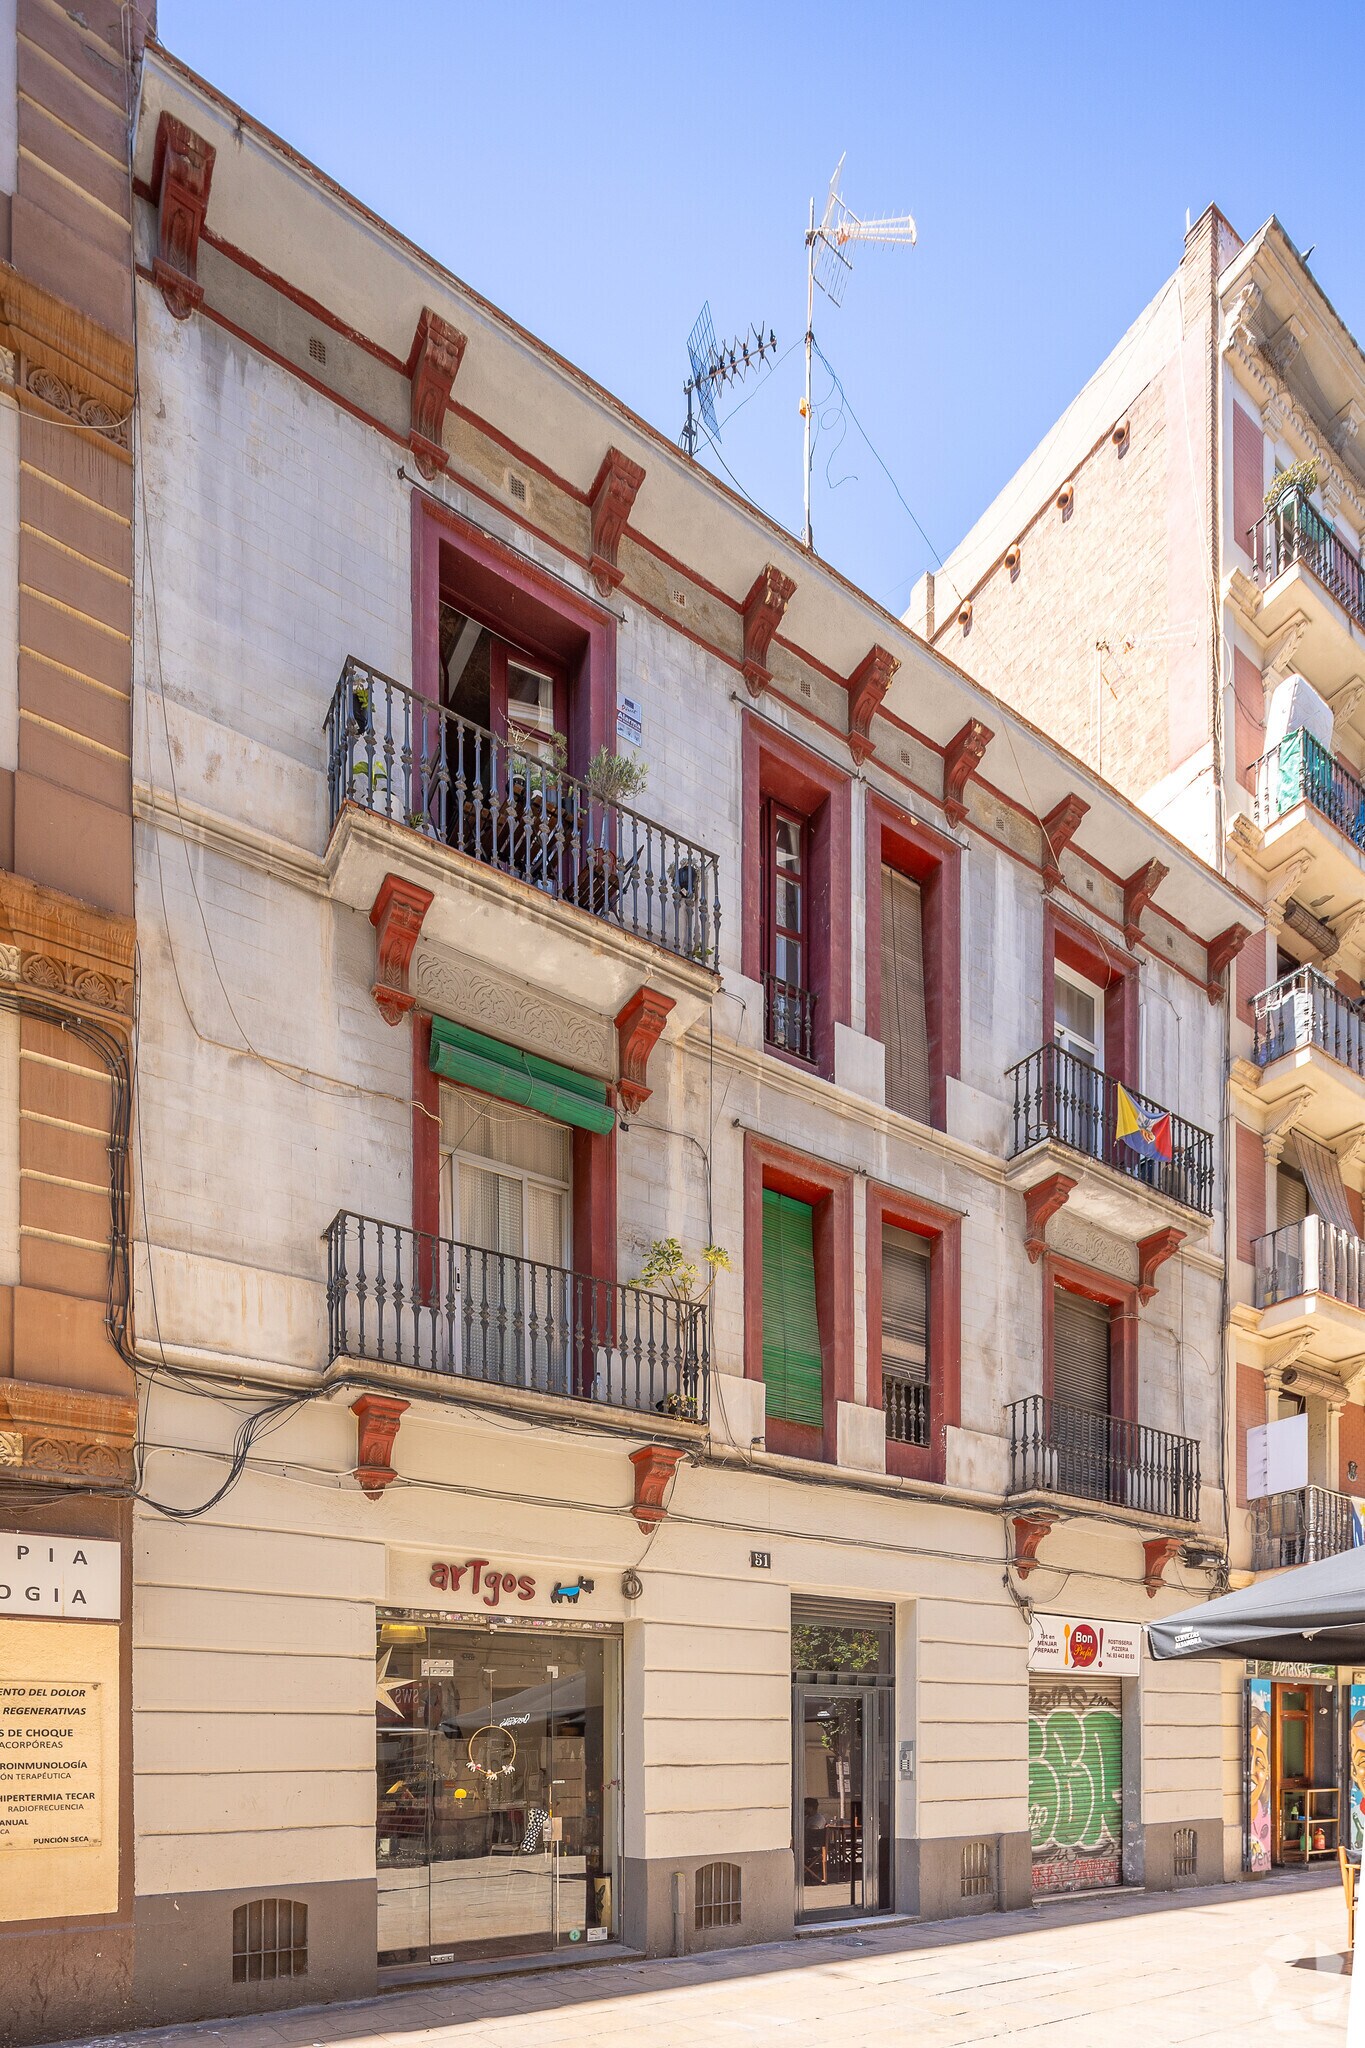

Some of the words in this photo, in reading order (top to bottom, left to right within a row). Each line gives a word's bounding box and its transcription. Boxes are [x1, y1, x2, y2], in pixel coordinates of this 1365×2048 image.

[17, 1545, 88, 1565] PIA
[754, 1553, 768, 1567] 51
[0, 1584, 87, 1604] OGIA
[1075, 1631, 1093, 1644] Bon
[29, 1689, 48, 1697] DEL
[50, 1689, 86, 1697] DOLOR
[3, 1707, 86, 1715] REGENERATIVAS
[8, 1729, 22, 1737] DE
[25, 1729, 74, 1738] CHOQUE
[16, 1771, 72, 1780] TERAPÉUTICA
[65, 1792, 95, 1800] TECAR
[8, 1804, 84, 1812] RADIOFRECUENCIA
[33, 1836, 69, 1844] PUNCIÓN
